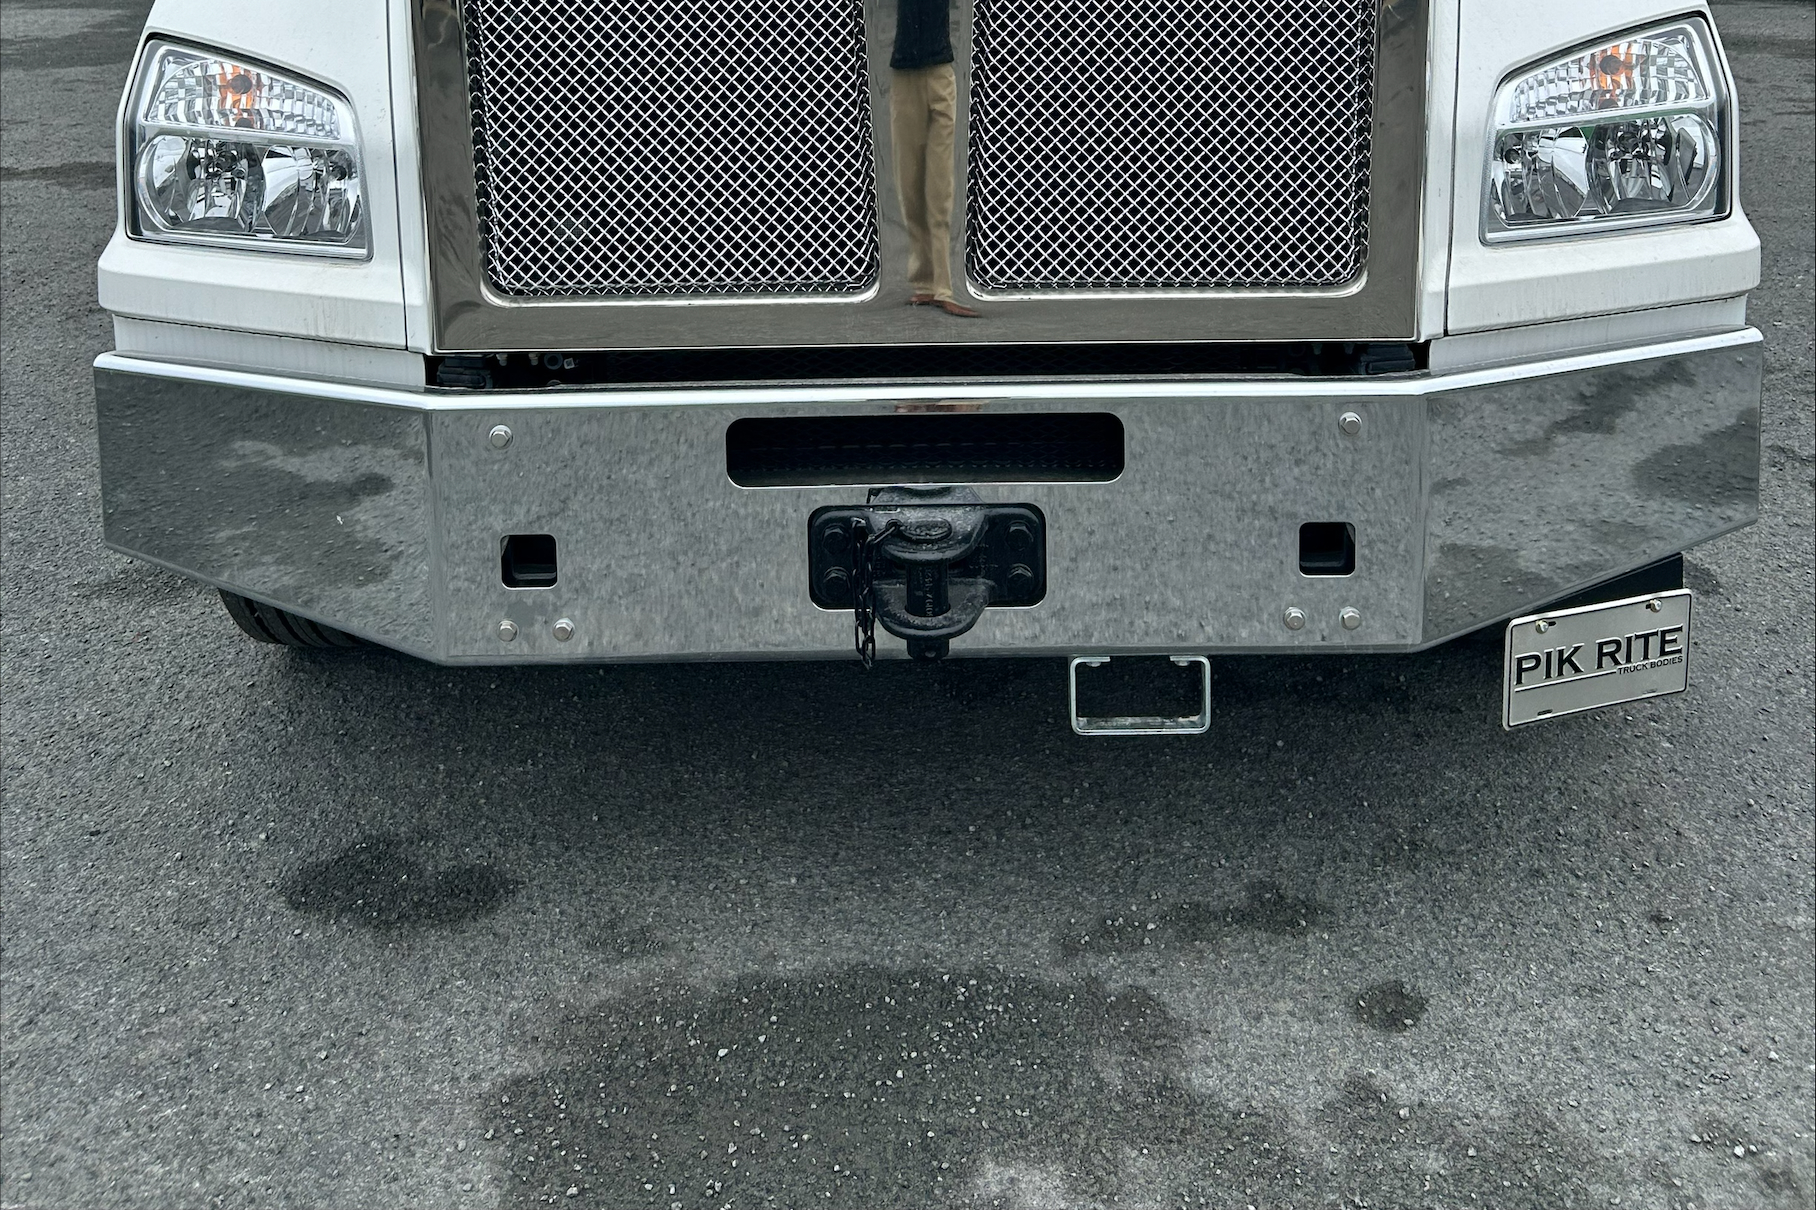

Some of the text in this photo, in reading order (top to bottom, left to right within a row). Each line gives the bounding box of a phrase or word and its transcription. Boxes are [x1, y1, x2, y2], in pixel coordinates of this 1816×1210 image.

[1514, 623, 1684, 686] PIK RITE
[1617, 655, 1684, 676] TRUCK BODIES
